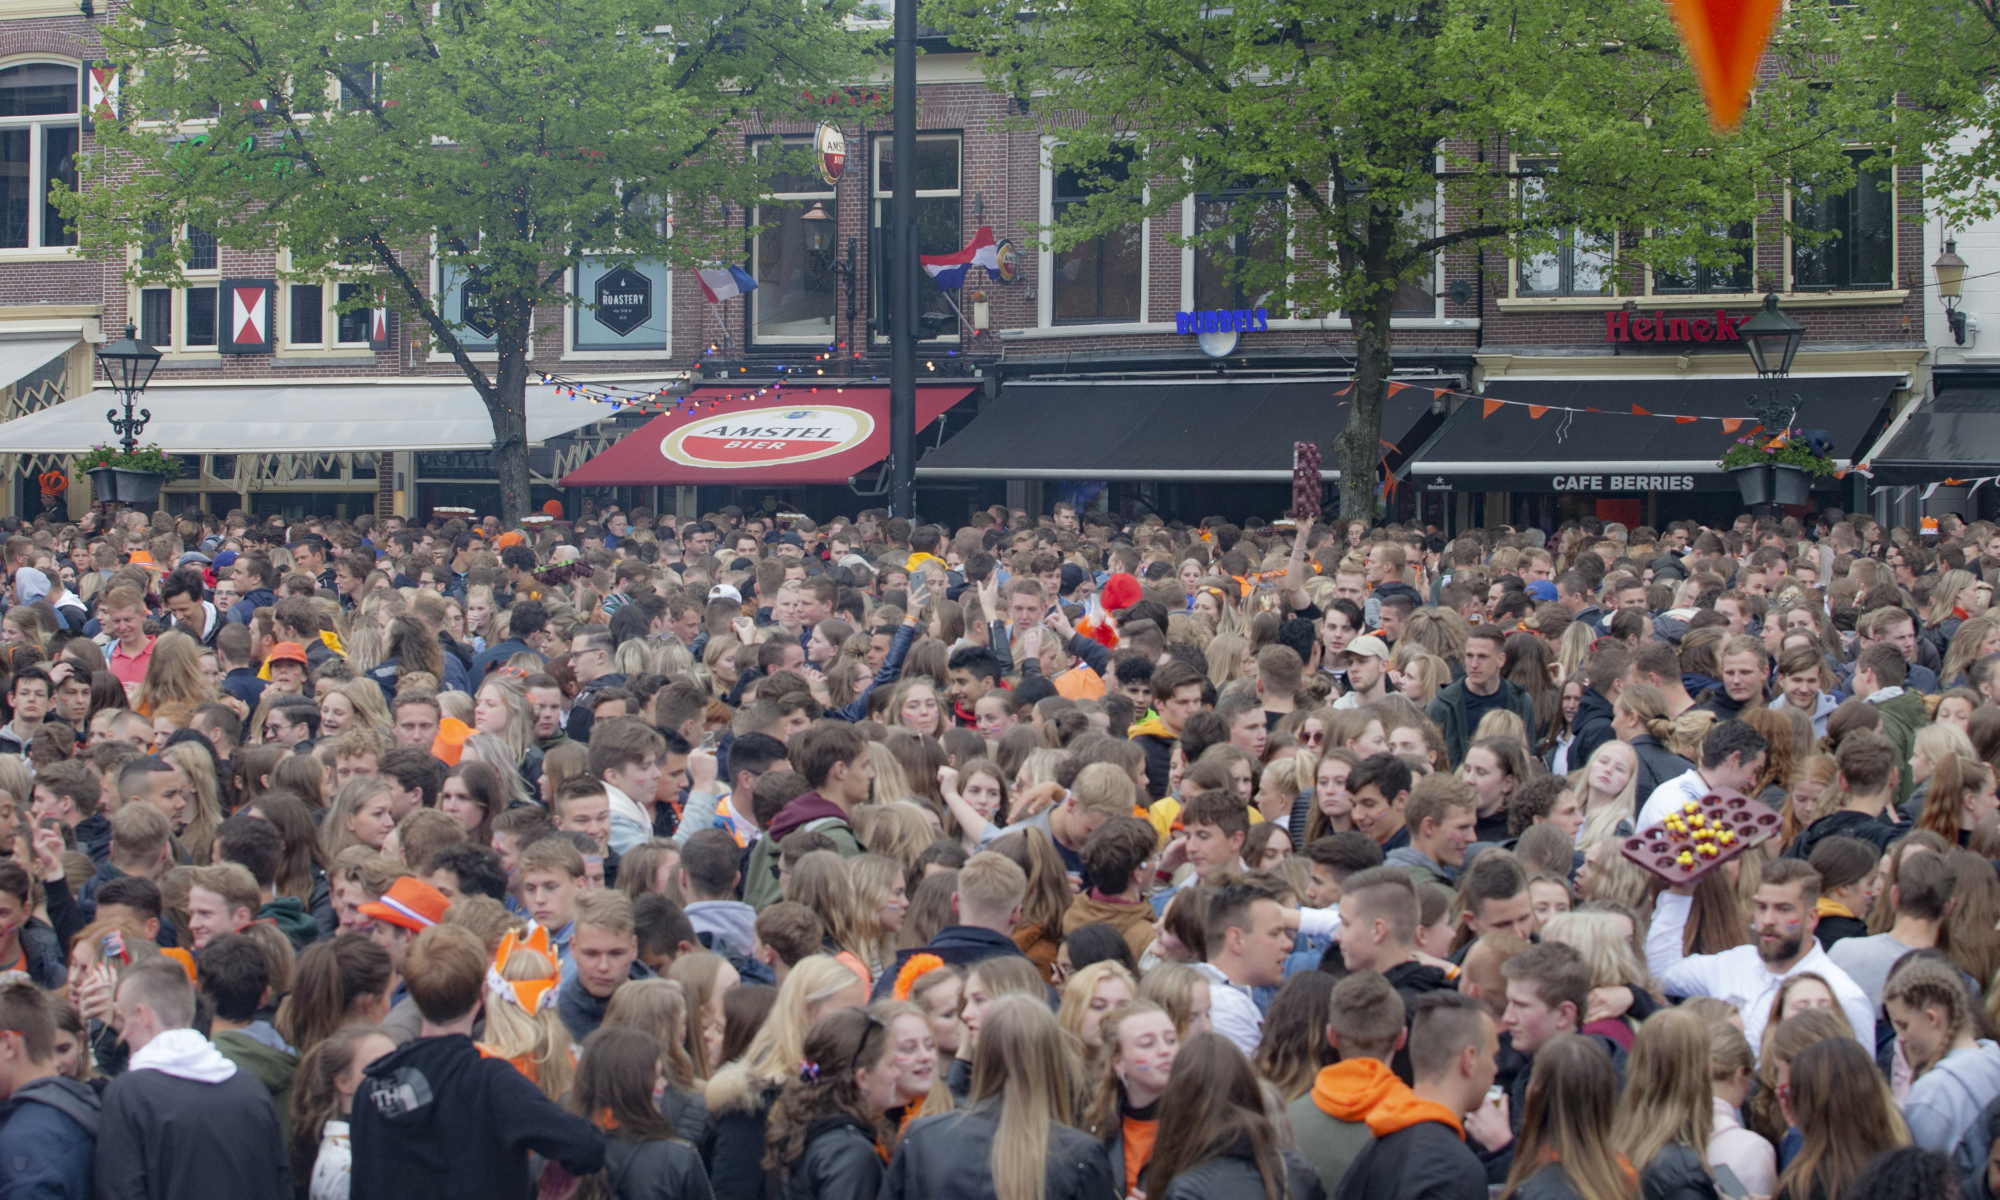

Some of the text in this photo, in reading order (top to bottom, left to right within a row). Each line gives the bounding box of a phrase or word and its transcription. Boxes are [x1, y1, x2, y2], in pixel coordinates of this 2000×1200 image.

[602, 294, 644, 306] ROASTERY
[1175, 308, 1267, 335] BUBBELS
[1604, 310, 1754, 342] Heinek
[703, 425, 834, 439] AMSTEL
[723, 440, 787, 450] BIER
[1552, 475, 1694, 491] CAFE BERRIES
